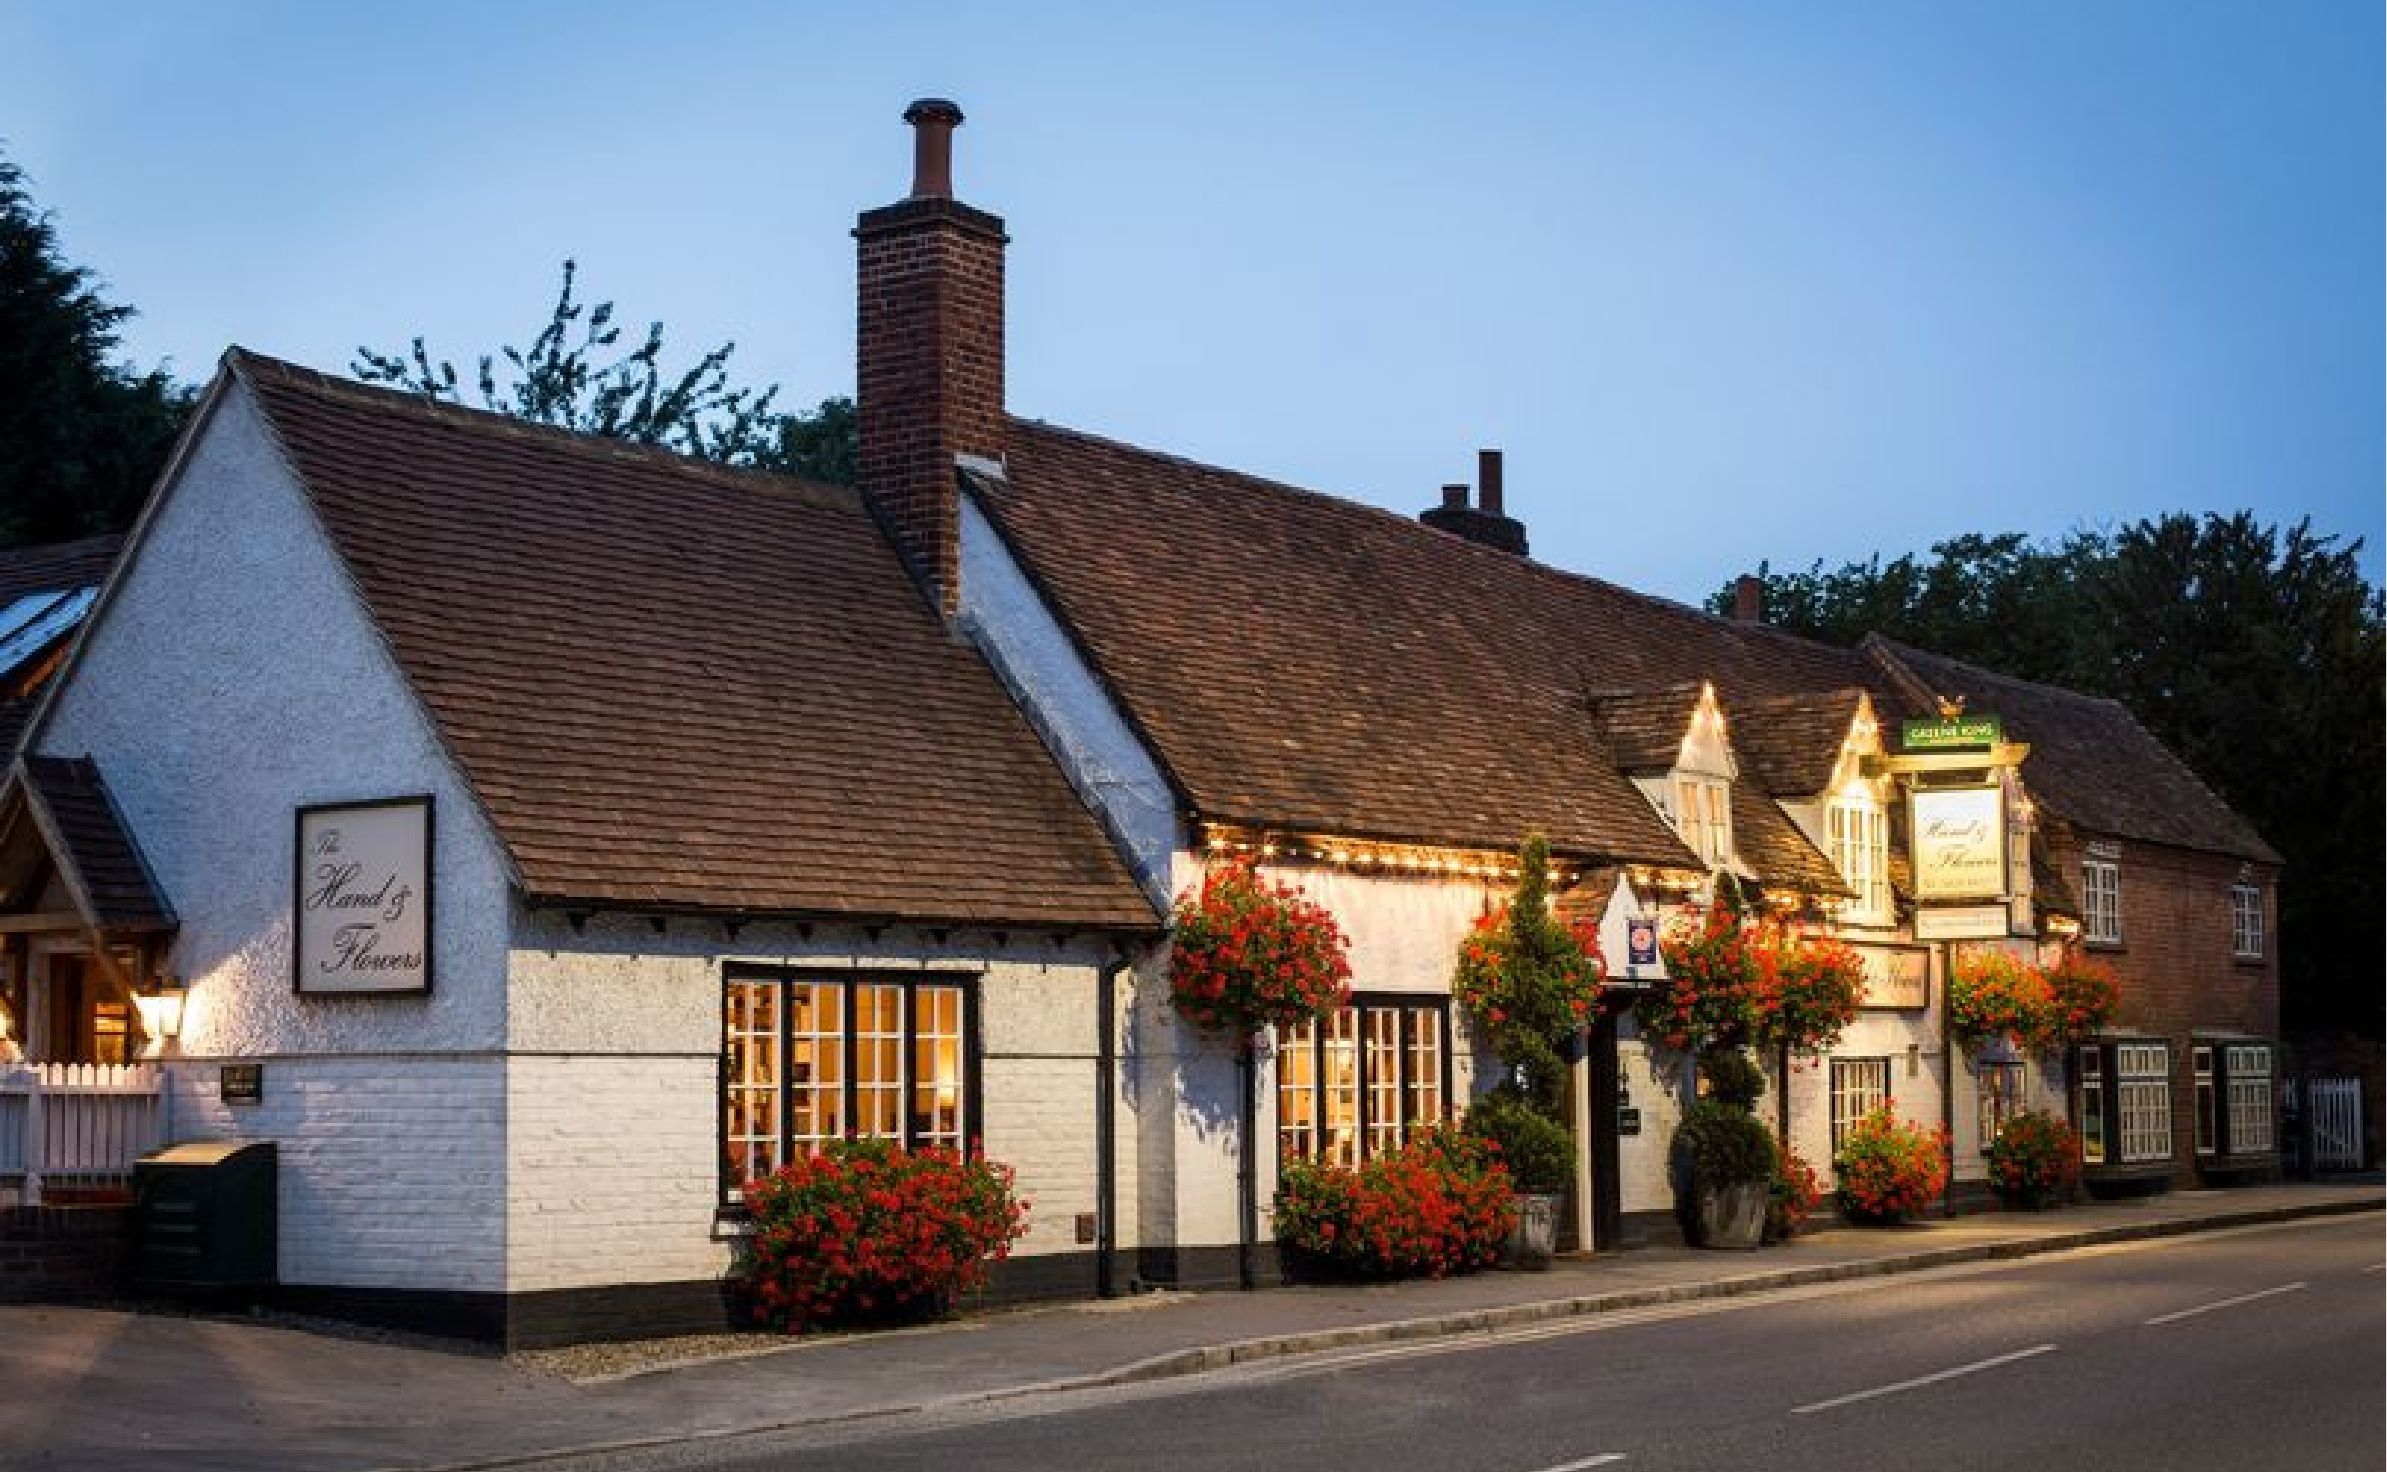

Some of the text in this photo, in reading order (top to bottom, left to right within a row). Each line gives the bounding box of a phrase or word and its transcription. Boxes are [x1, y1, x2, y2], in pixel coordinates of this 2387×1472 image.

[313, 828, 341, 854] The
[305, 862, 413, 921] Hand &
[321, 922, 422, 973] Flowers
